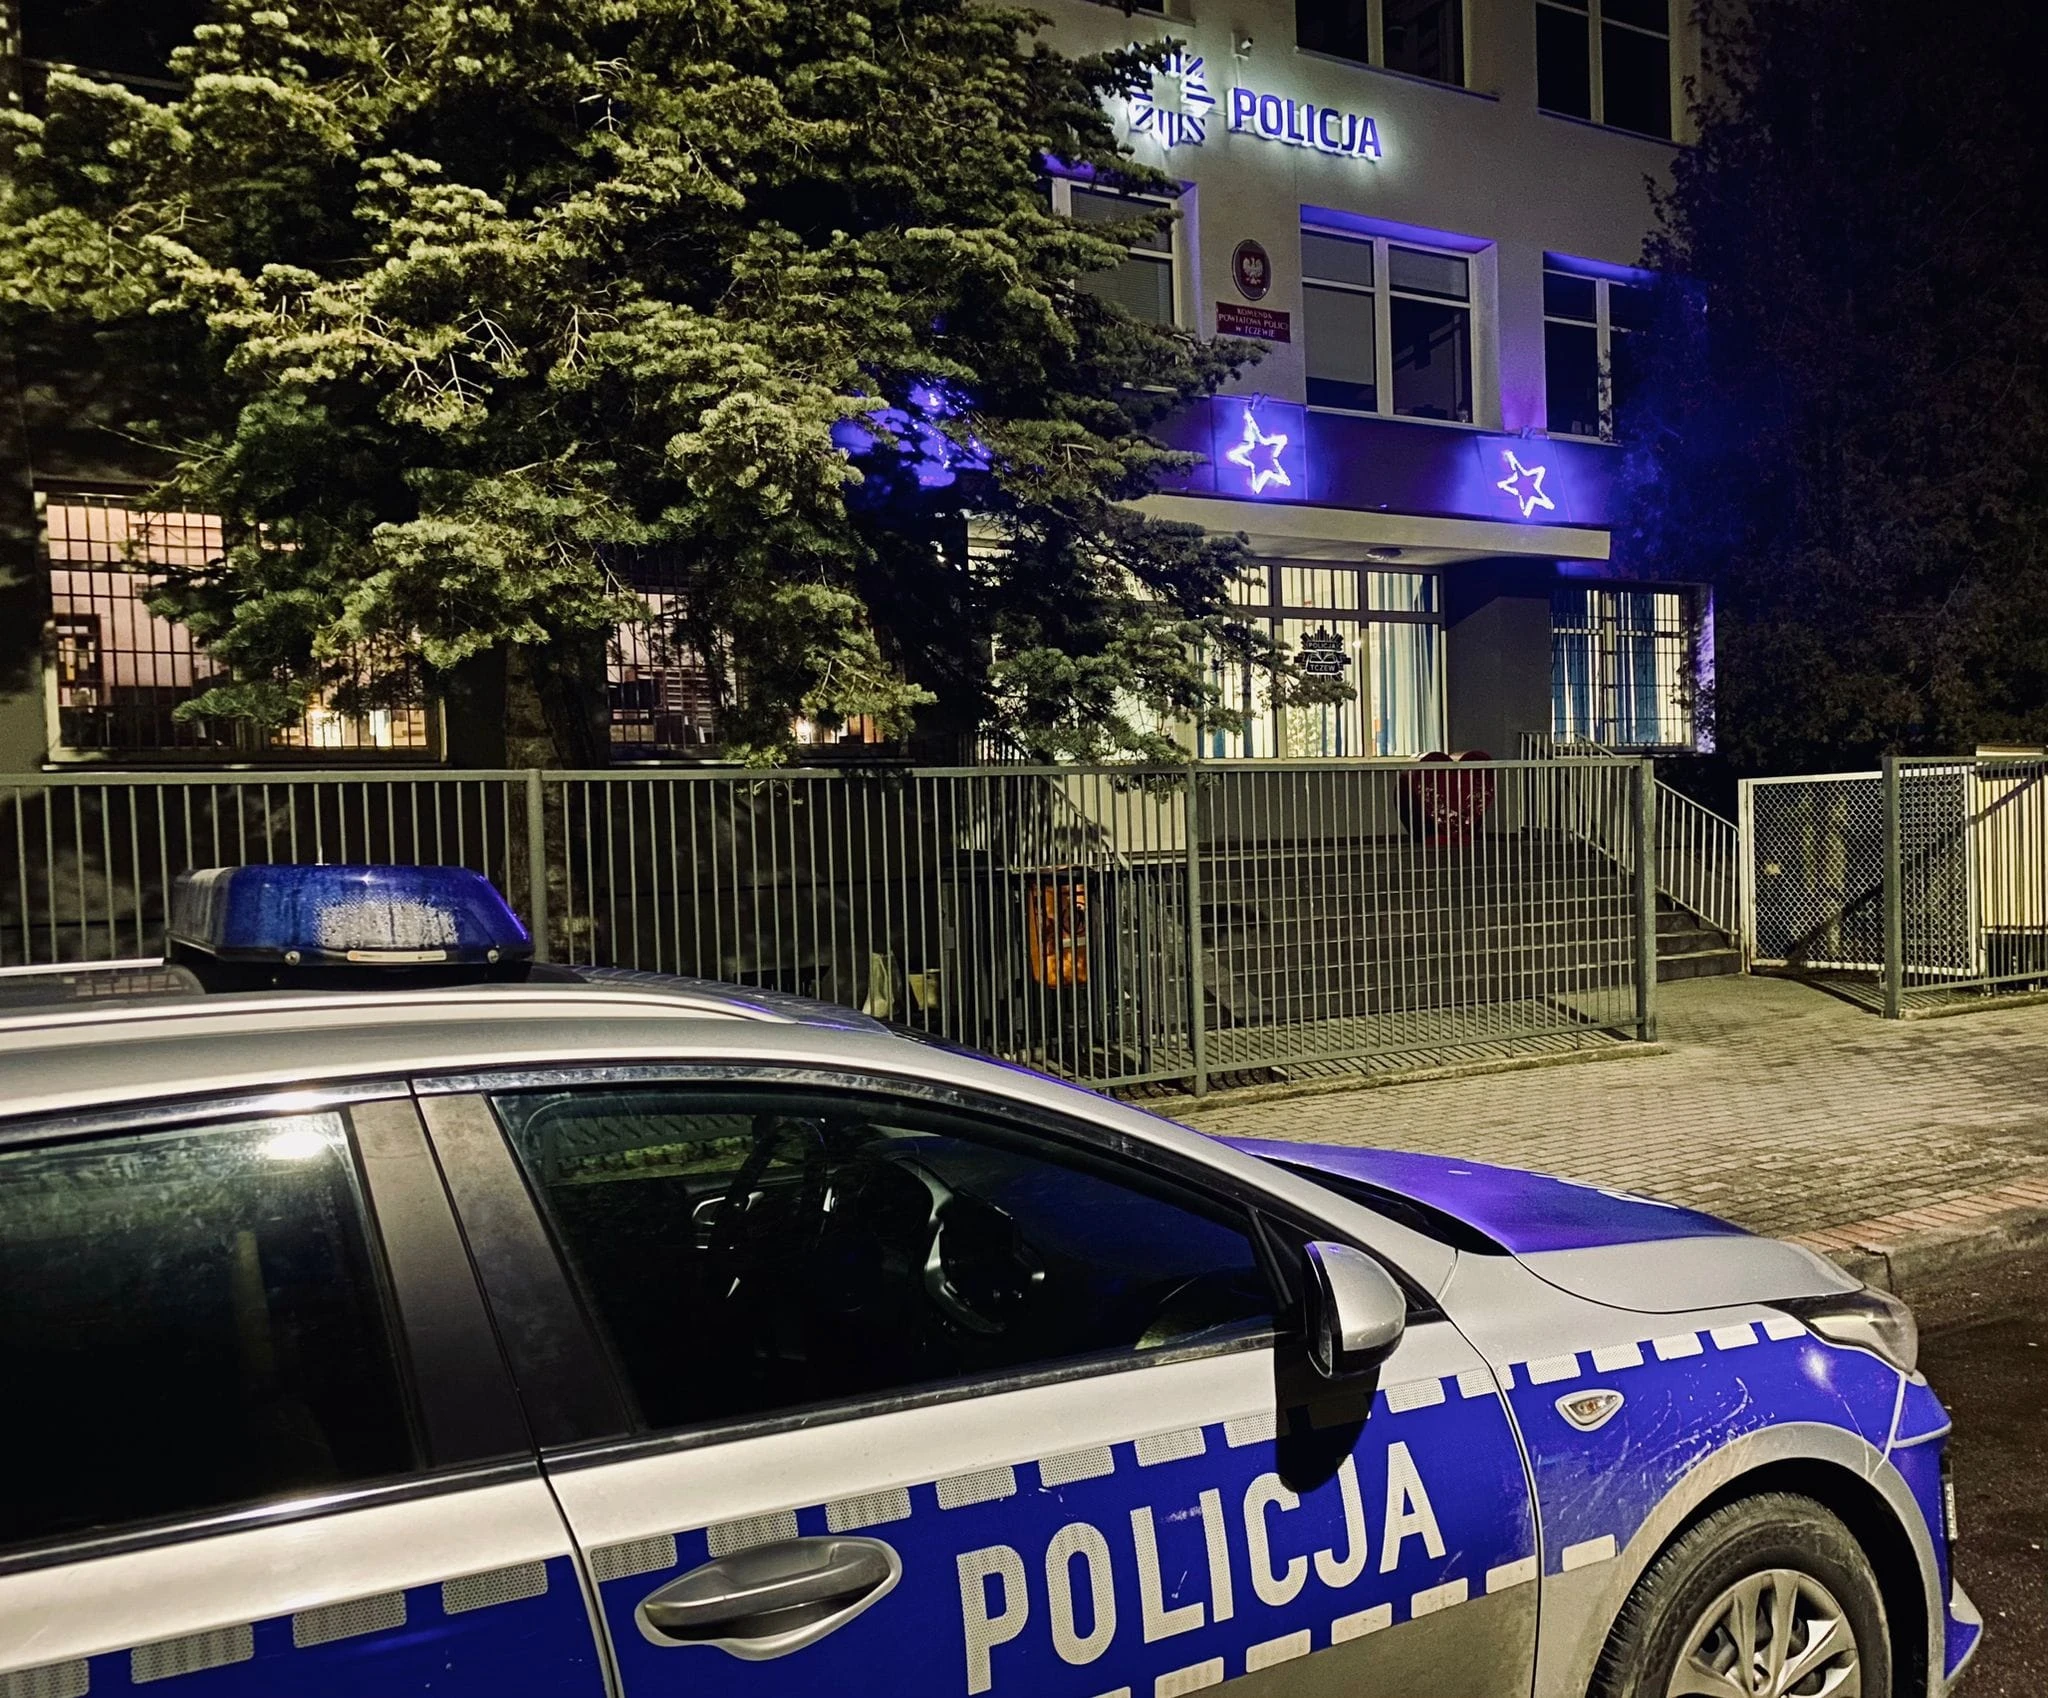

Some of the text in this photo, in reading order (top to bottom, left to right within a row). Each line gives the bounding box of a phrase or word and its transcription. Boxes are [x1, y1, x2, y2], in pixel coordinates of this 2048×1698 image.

[1227, 87, 1383, 160] POLICJA
[1218, 314, 1262, 326] POWIATOWA
[1237, 308, 1272, 320] KOMENDA
[1245, 326, 1275, 338] TCZEWIE
[1310, 664, 1336, 672] TCZEW
[956, 1441, 1447, 1696] POLICJA
